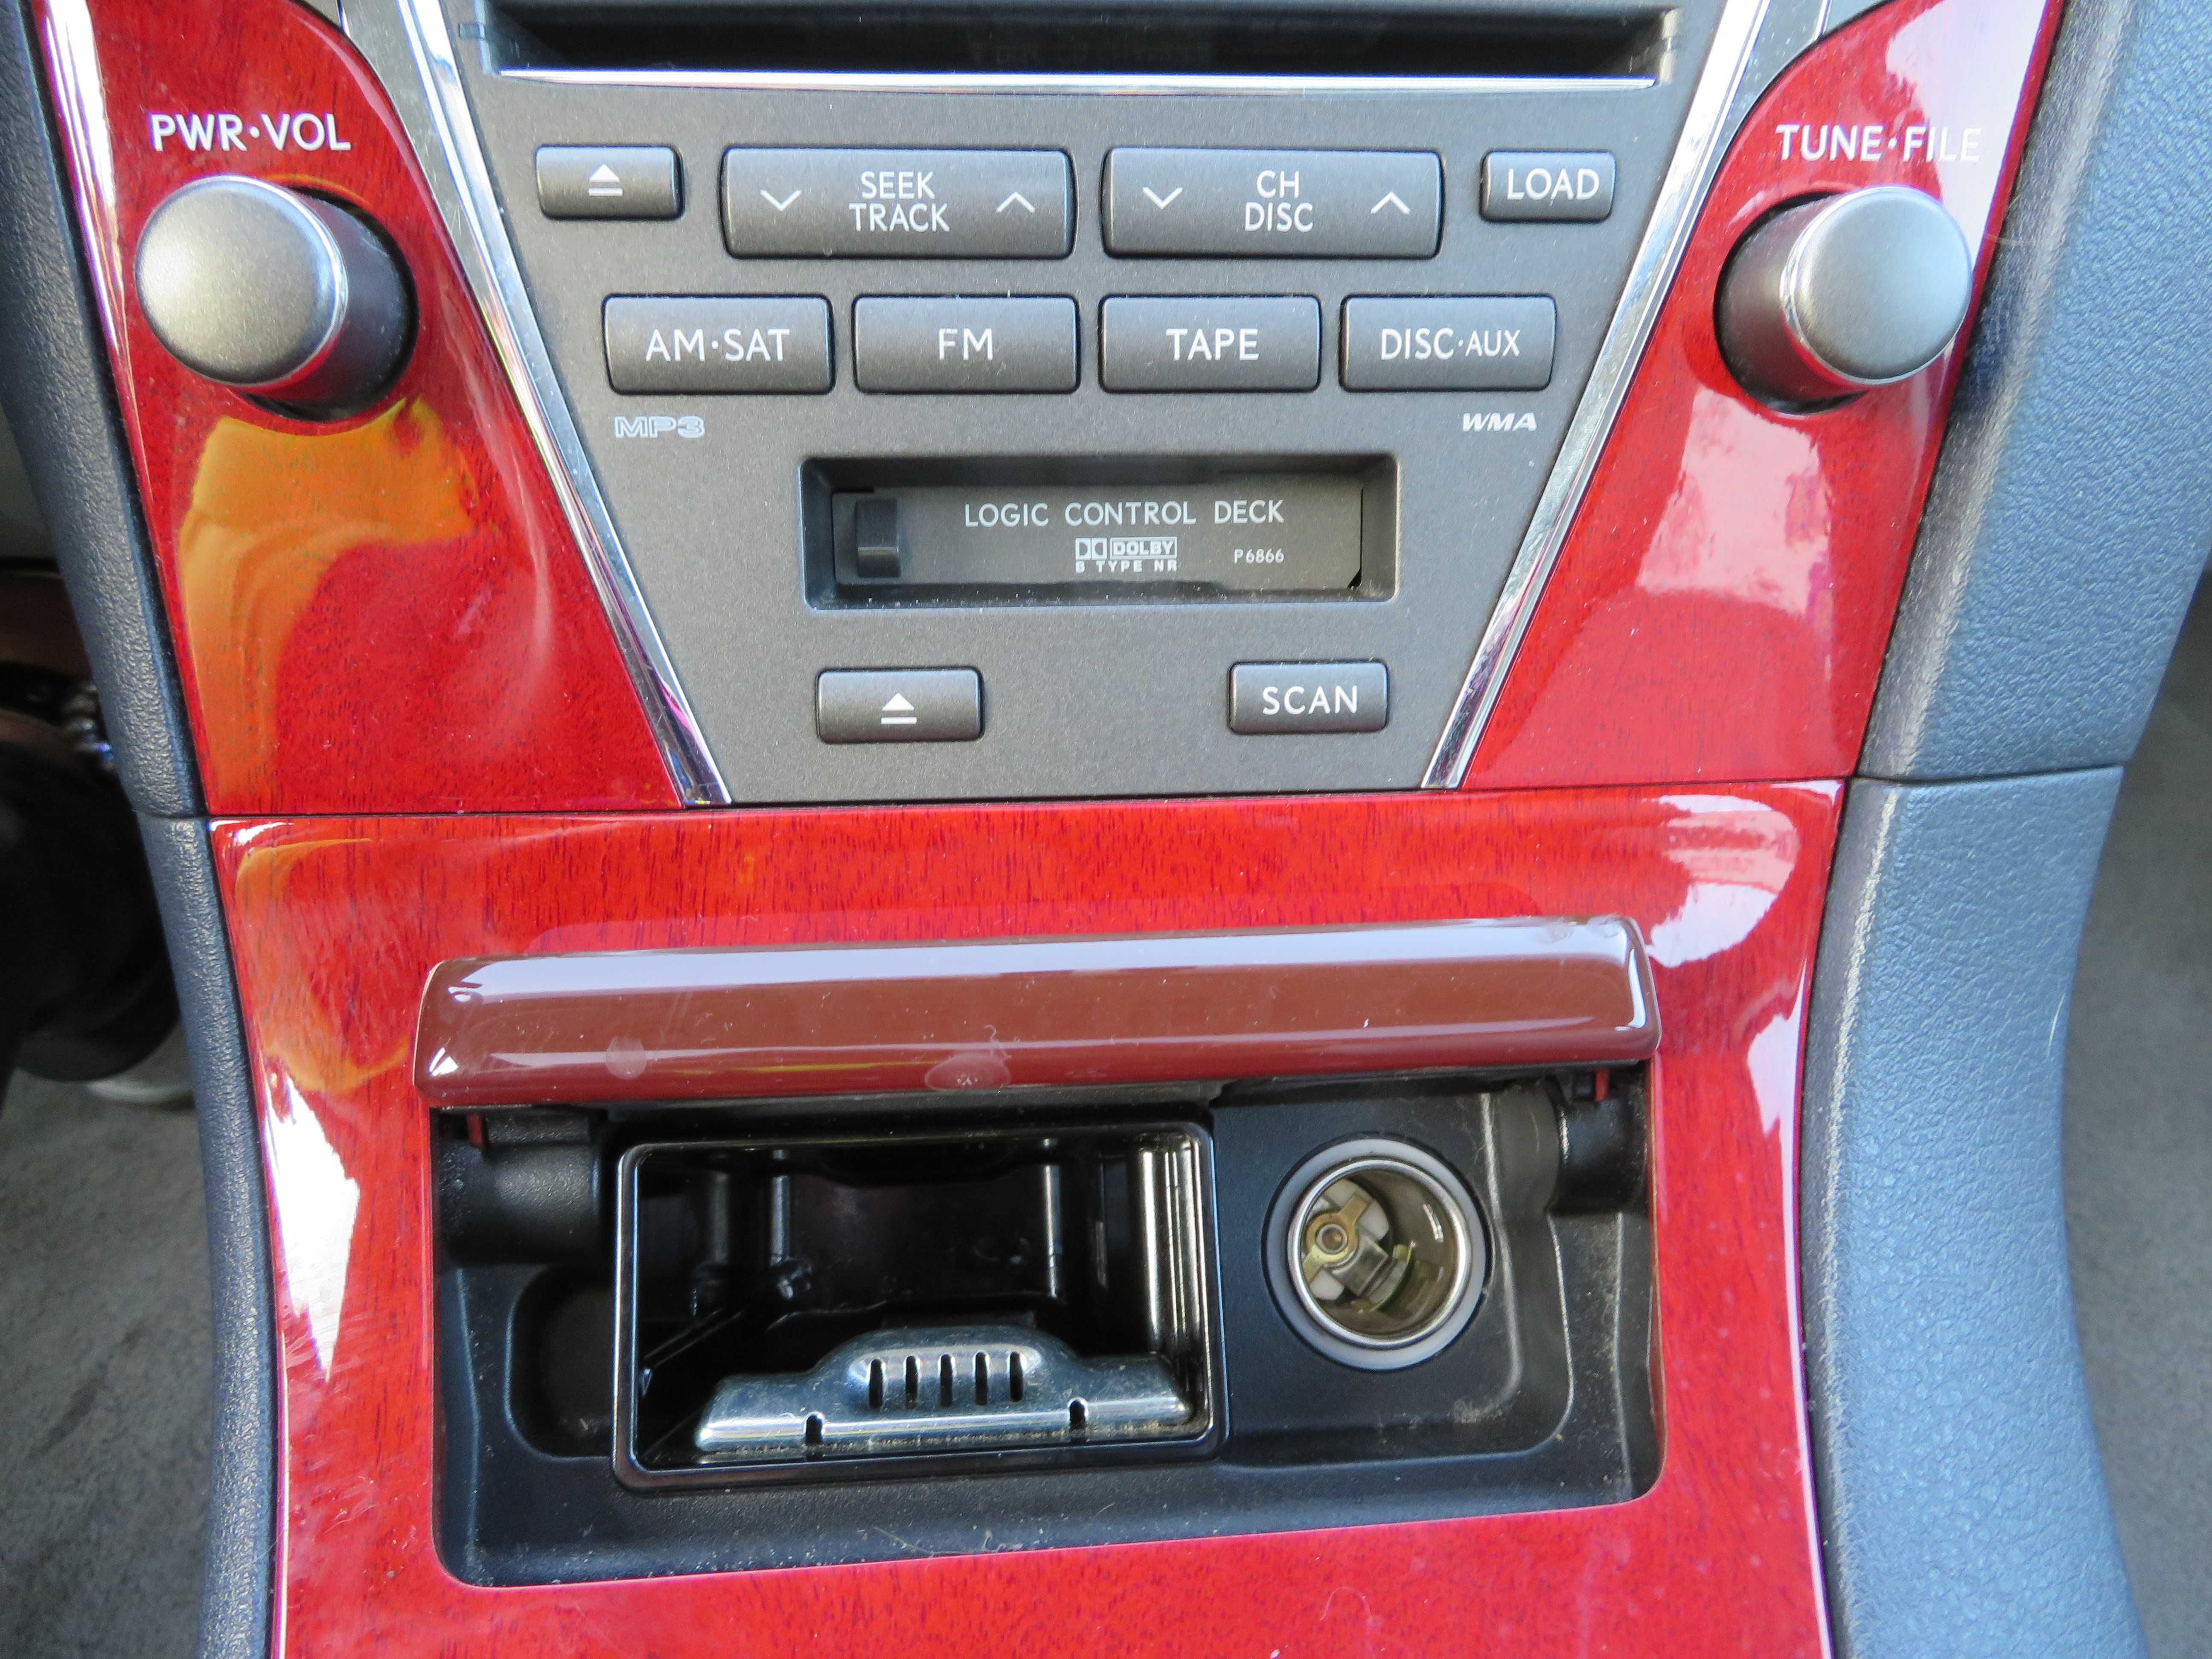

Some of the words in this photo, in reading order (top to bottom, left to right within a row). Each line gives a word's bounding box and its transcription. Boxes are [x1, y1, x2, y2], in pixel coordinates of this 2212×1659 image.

[861, 172, 934, 198] SEEK
[1257, 171, 1299, 198] CH
[1508, 169, 1599, 199] LOAD
[849, 204, 949, 231] TRACK
[1245, 202, 1313, 232] DISC
[939, 329, 993, 360] FM
[1166, 329, 1259, 360] TAPE
[615, 416, 705, 438] MP3
[1463, 413, 1536, 431] WMA
[966, 503, 1048, 527] LOGIC
[1065, 501, 1196, 526] CONTROL
[1215, 500, 1284, 524] DECK
[1113, 539, 1174, 556] DOLBY
[1234, 549, 1284, 563] P6866
[1076, 561, 1085, 573] B
[1096, 559, 1142, 572] TYPE
[1154, 559, 1178, 572] NR
[1263, 686, 1357, 715] SCAN
